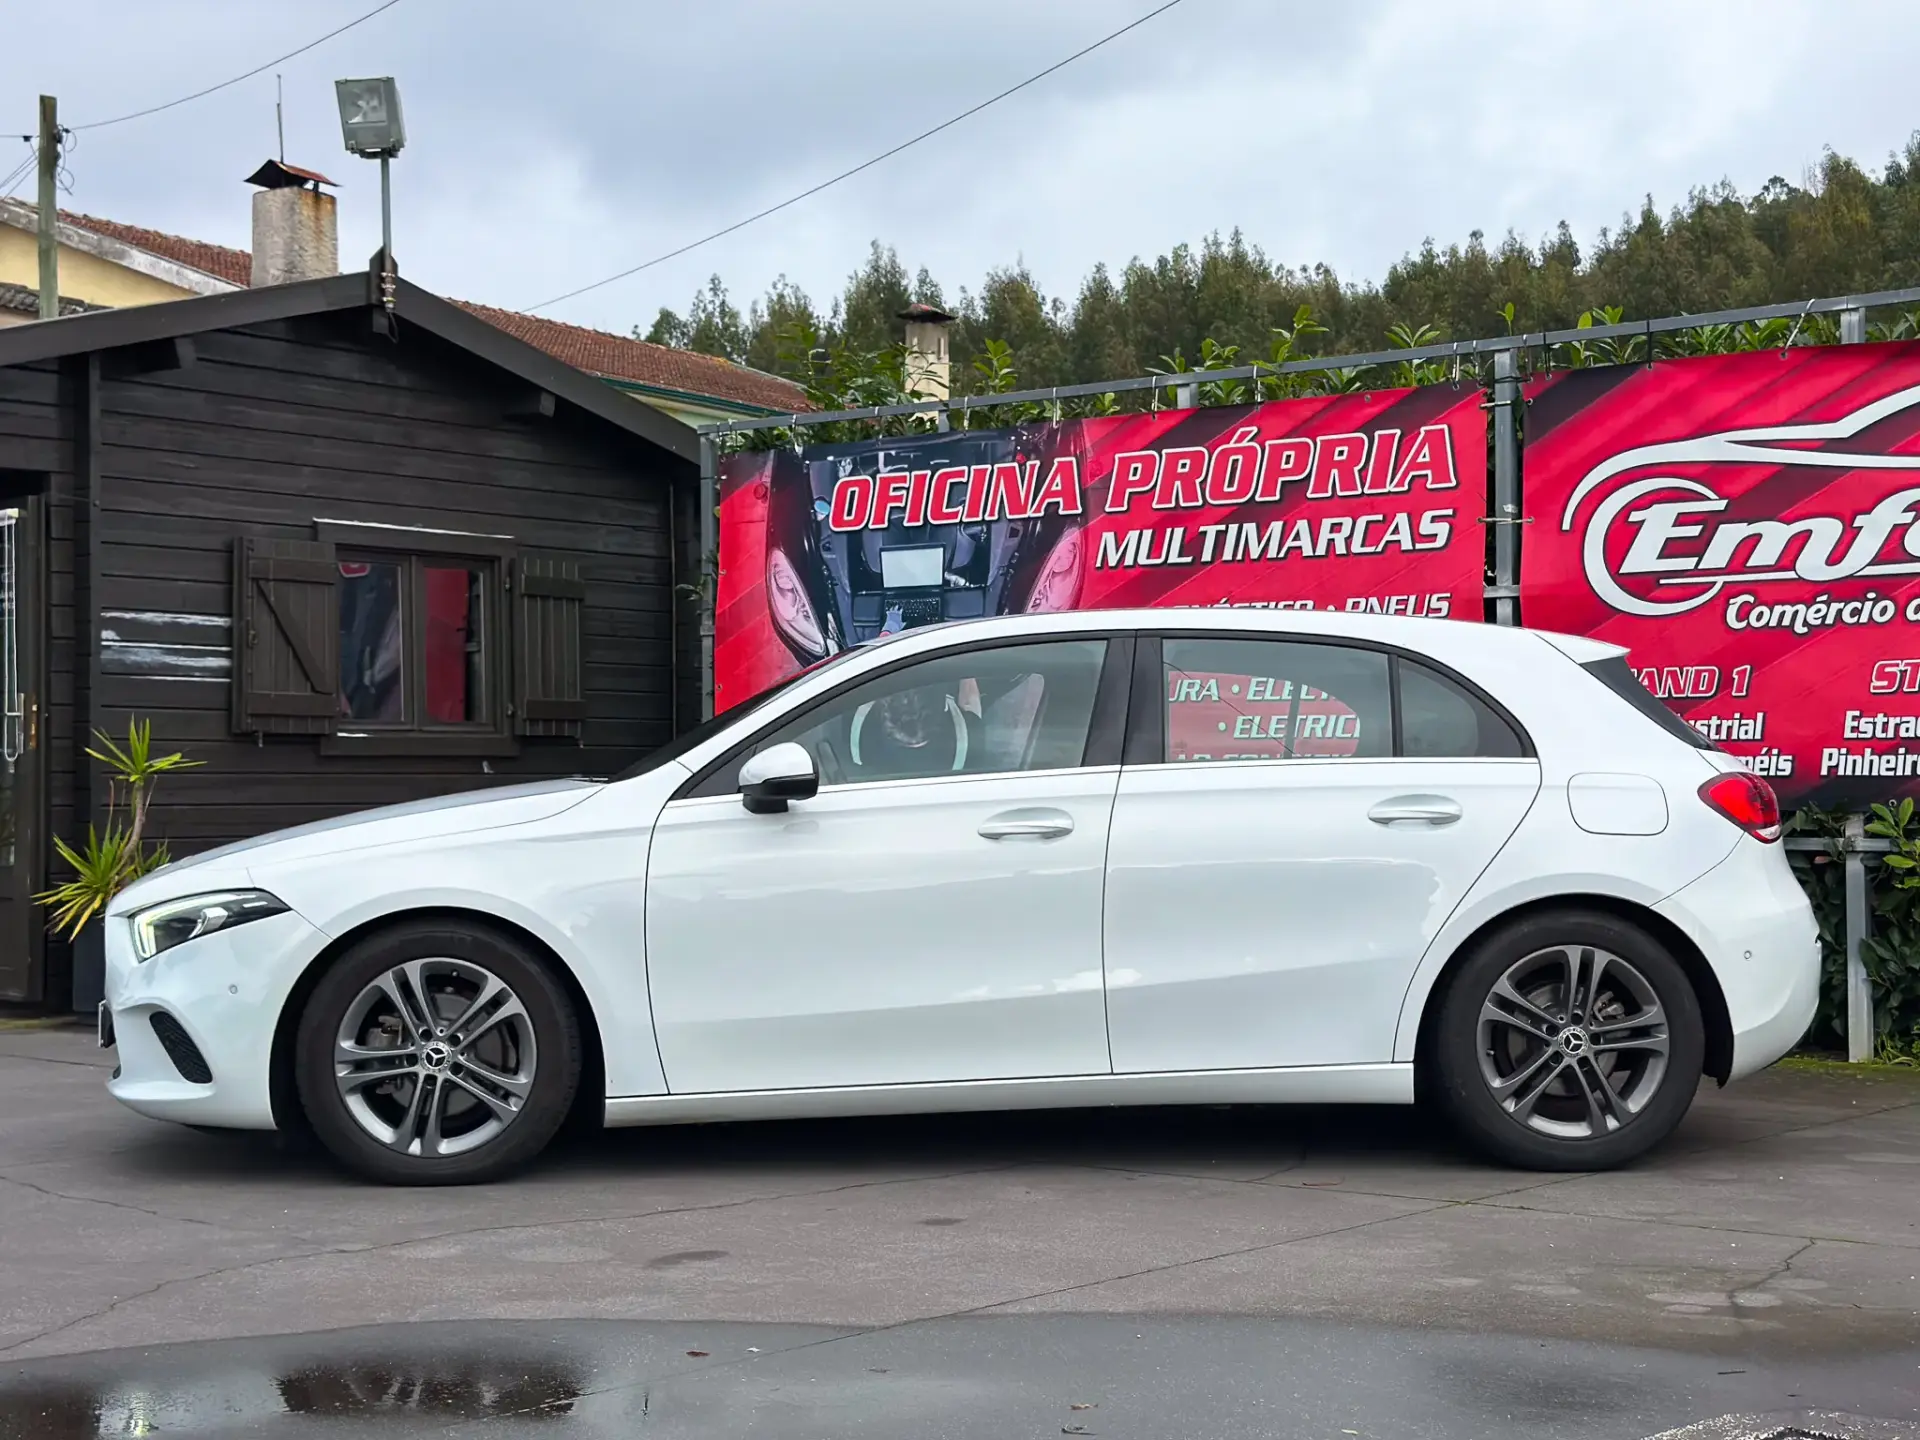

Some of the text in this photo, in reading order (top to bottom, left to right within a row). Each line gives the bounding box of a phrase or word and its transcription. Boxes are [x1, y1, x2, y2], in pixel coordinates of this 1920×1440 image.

[828, 424, 1457, 532] OFICINA PRÓPRIA
[1095, 508, 1454, 568] MULTIMARCAS
[1726, 591, 1896, 633] Comércio
[1631, 664, 1752, 698] AND 1
[1820, 747, 1920, 777] Pinheir
